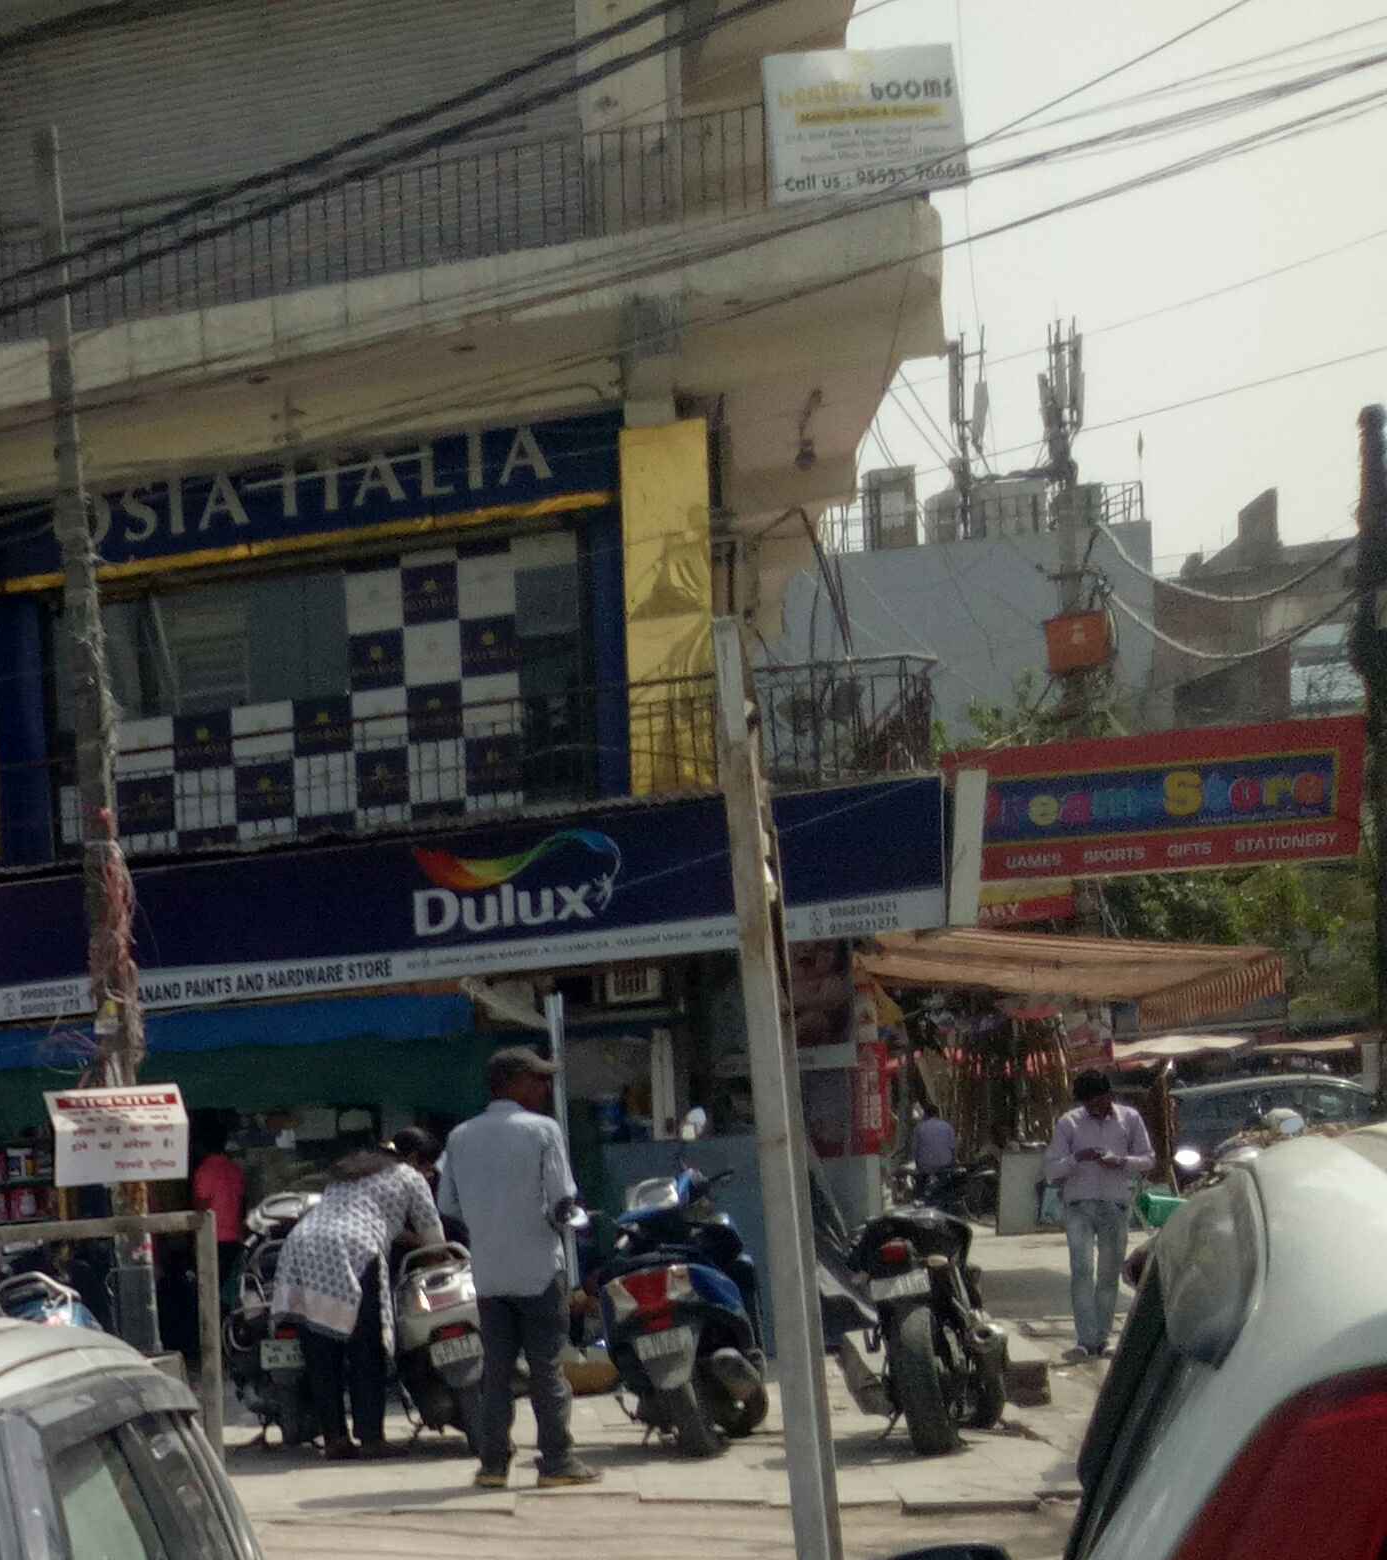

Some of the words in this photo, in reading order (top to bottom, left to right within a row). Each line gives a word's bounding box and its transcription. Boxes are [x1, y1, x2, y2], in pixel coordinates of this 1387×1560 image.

[1163, 770, 1326, 817] Store
[1082, 846, 1146, 865] SPORTS
[1167, 841, 1213, 859] GIFTS
[1234, 831, 1339, 852] STATIONERY
[413, 877, 594, 938] Dulux
[184, 974, 233, 998] PAINTS
[236, 972, 265, 994] AND
[267, 963, 345, 989] HARDWARE
[347, 957, 393, 982] STORE
